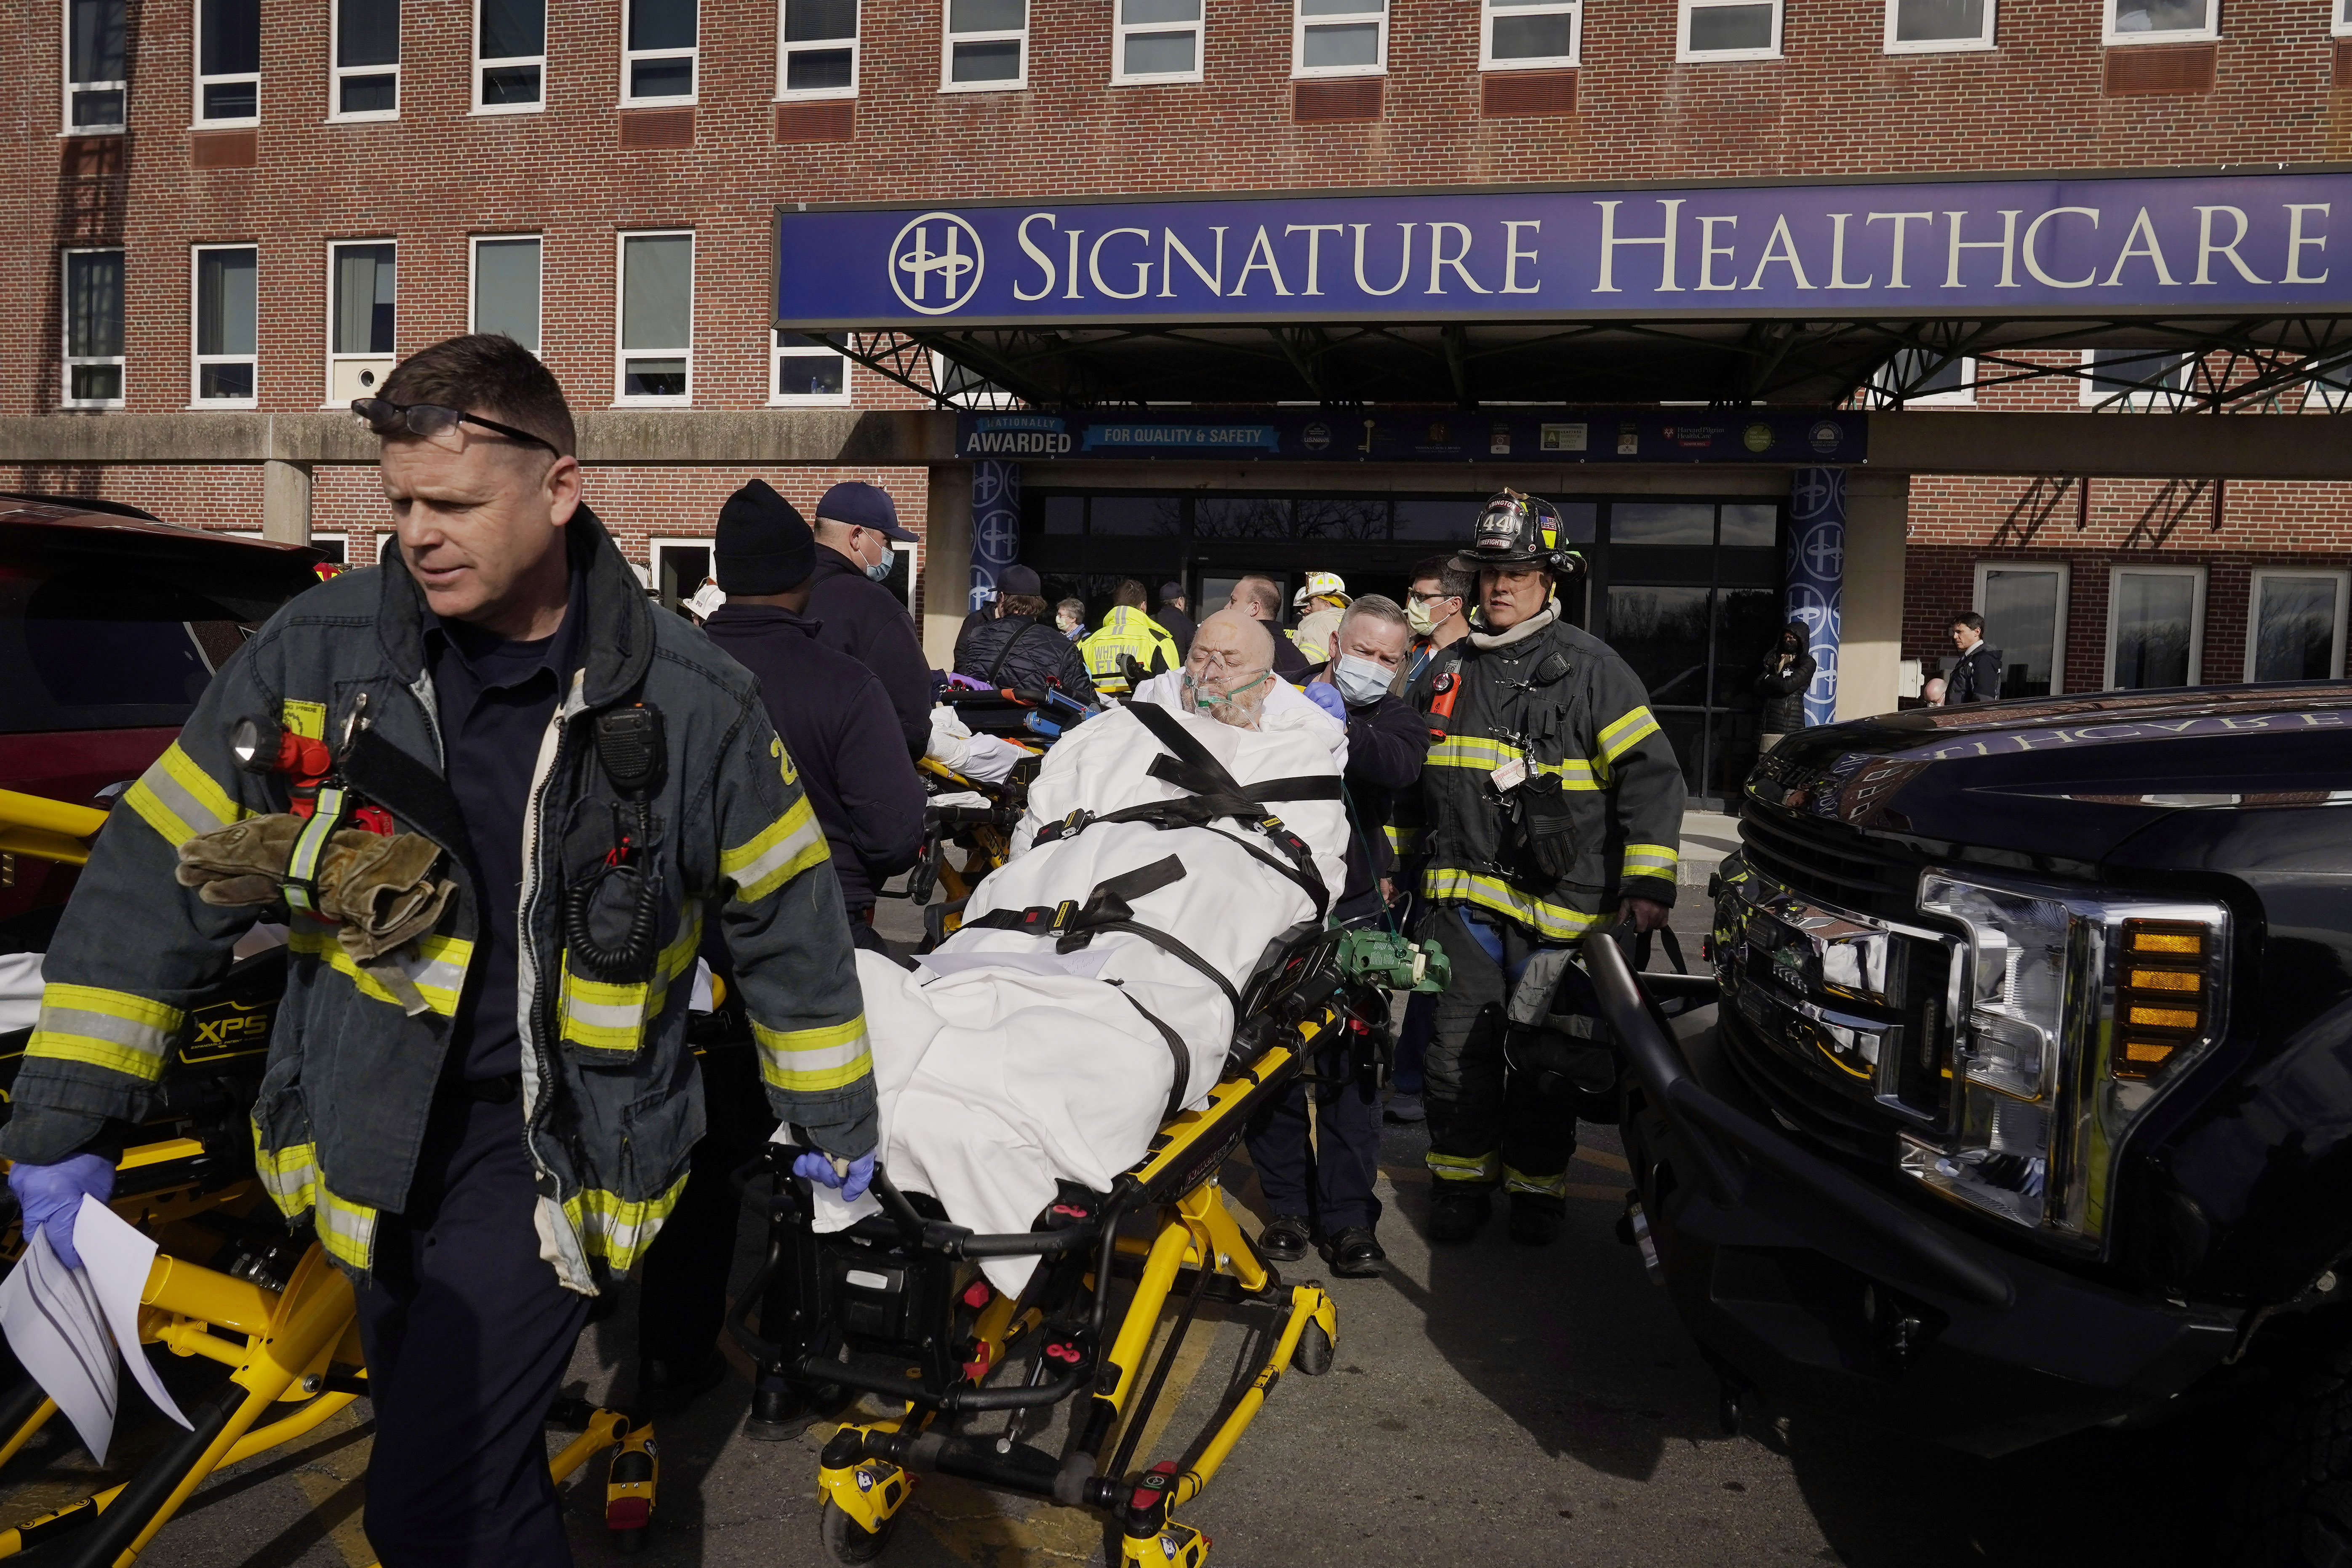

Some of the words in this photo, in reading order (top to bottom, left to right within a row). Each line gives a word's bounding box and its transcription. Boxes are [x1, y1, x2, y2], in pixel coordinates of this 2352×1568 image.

[1013, 213, 1541, 301] SIGNATURE
[1591, 199, 2331, 292] HEALTHCARE
[988, 418, 1055, 428] NATIONALLY
[966, 433, 1071, 453] AWARDED
[1105, 429, 1130, 442] FOR
[1134, 429, 1192, 442] QUALITY
[1196, 429, 1206, 443] &
[1210, 429, 1262, 443] SAFETY
[1488, 500, 1516, 510] ABINGTON
[1483, 513, 1510, 533] 44
[1478, 539, 1509, 547] FIREFIGHTER
[194, 1014, 268, 1043] XPS
